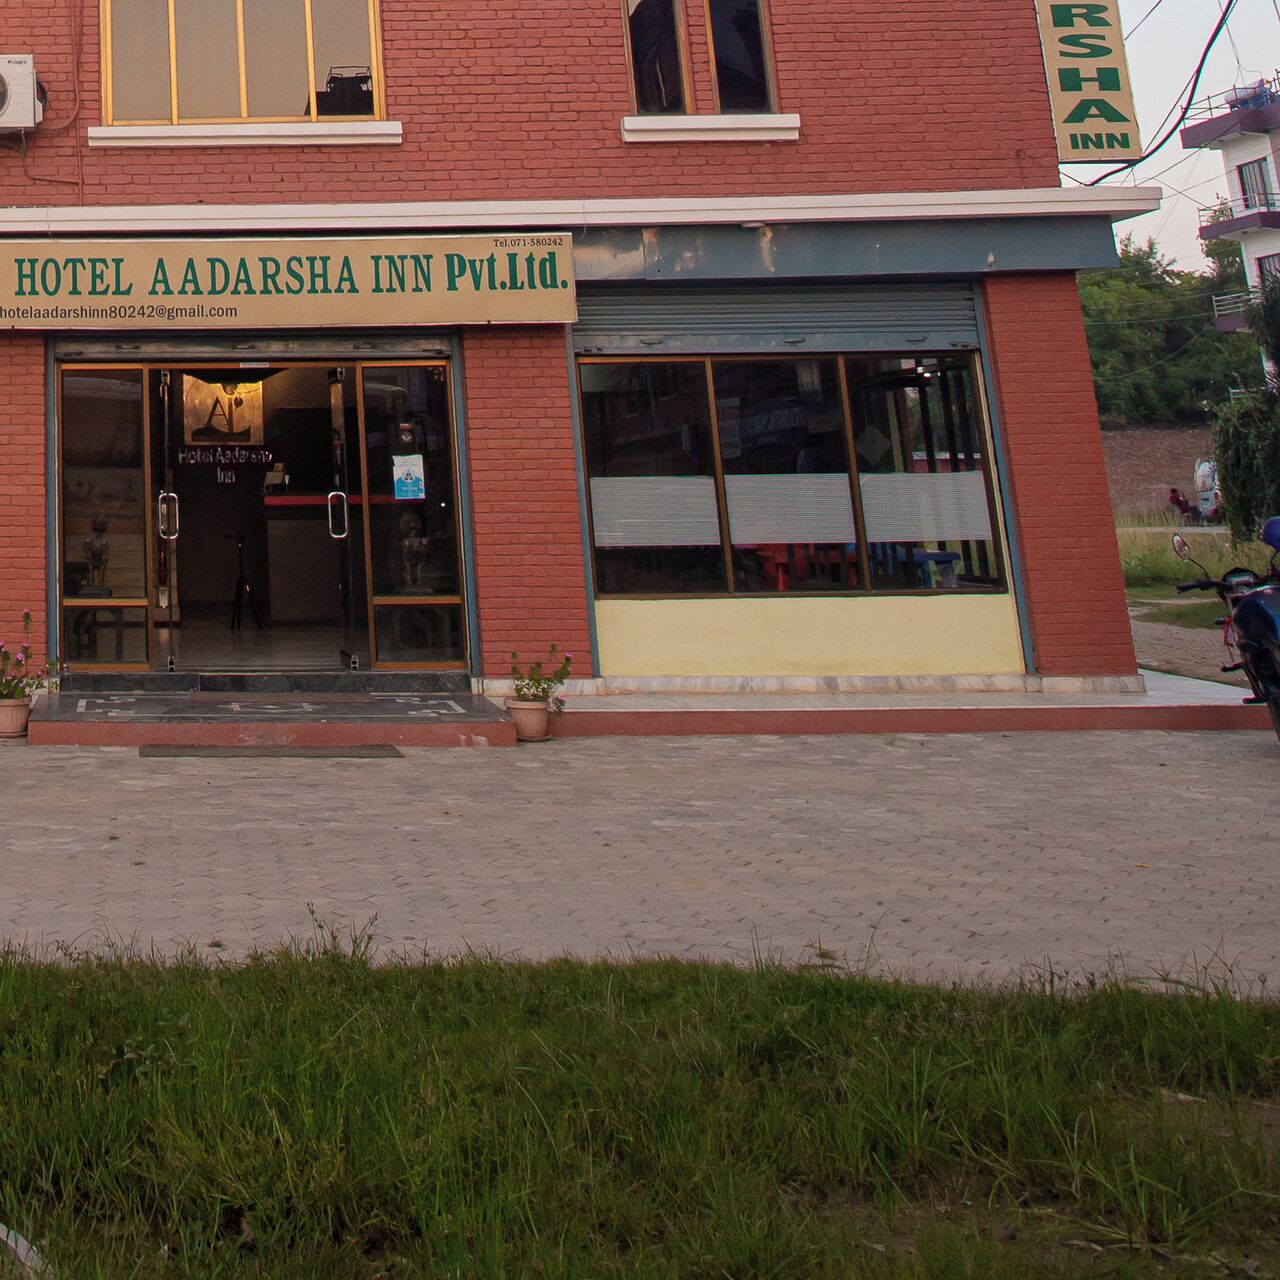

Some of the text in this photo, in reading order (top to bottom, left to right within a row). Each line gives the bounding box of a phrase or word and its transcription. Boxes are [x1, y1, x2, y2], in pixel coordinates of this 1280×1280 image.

[1069, 131, 1132, 150] INN
[492, 237, 564, 248] Tel.071-580242
[14, 257, 133, 297] HOTEL
[149, 255, 360, 296] AADARSHA
[370, 254, 434, 294] INN
